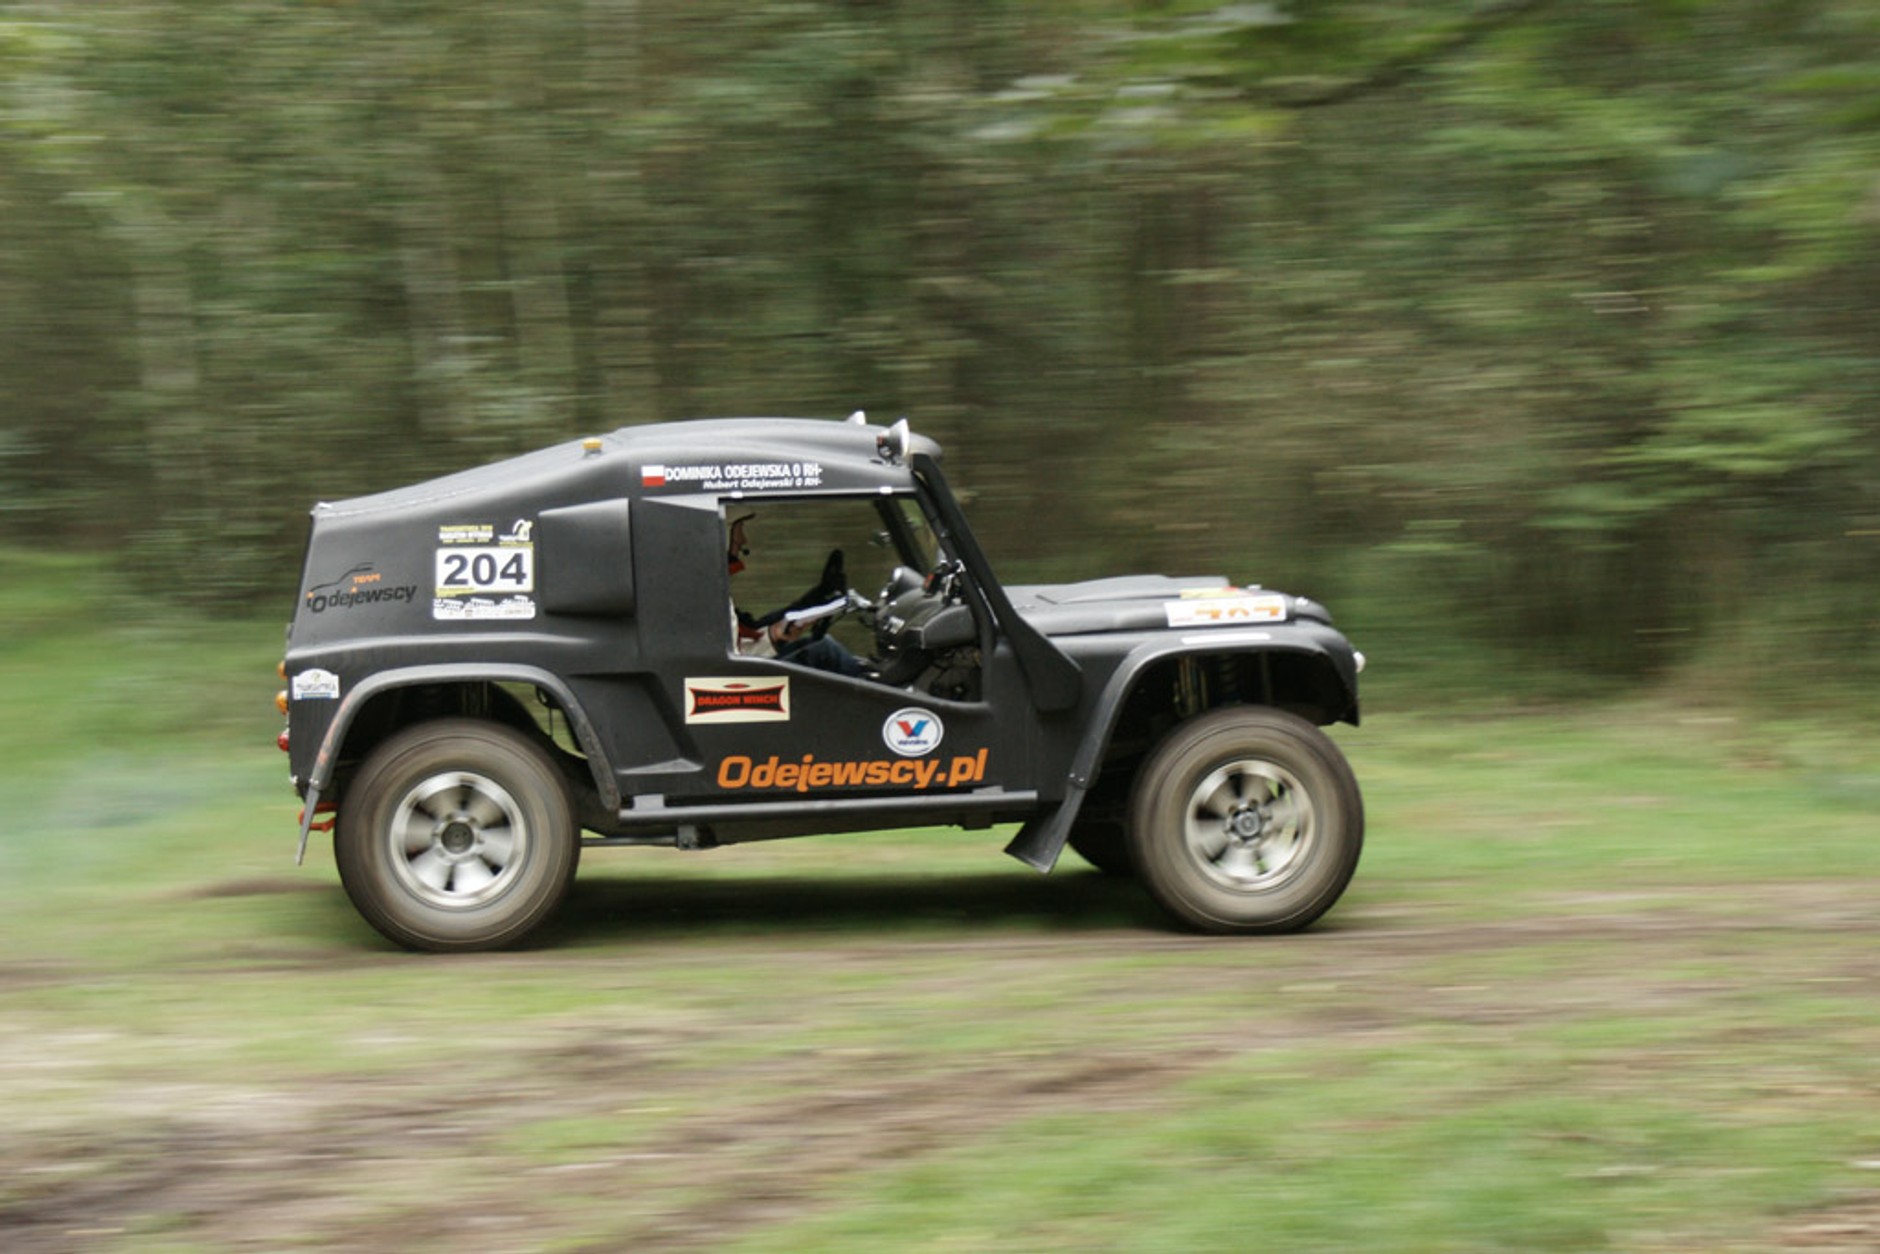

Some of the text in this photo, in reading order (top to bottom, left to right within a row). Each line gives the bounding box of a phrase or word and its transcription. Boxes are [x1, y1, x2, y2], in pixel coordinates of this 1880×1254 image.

[665, 466, 723, 481] DOMINIKA
[724, 464, 791, 478] ODEJEWSKA
[443, 552, 528, 587] 204
[716, 748, 988, 792] Odejewscy.pl
